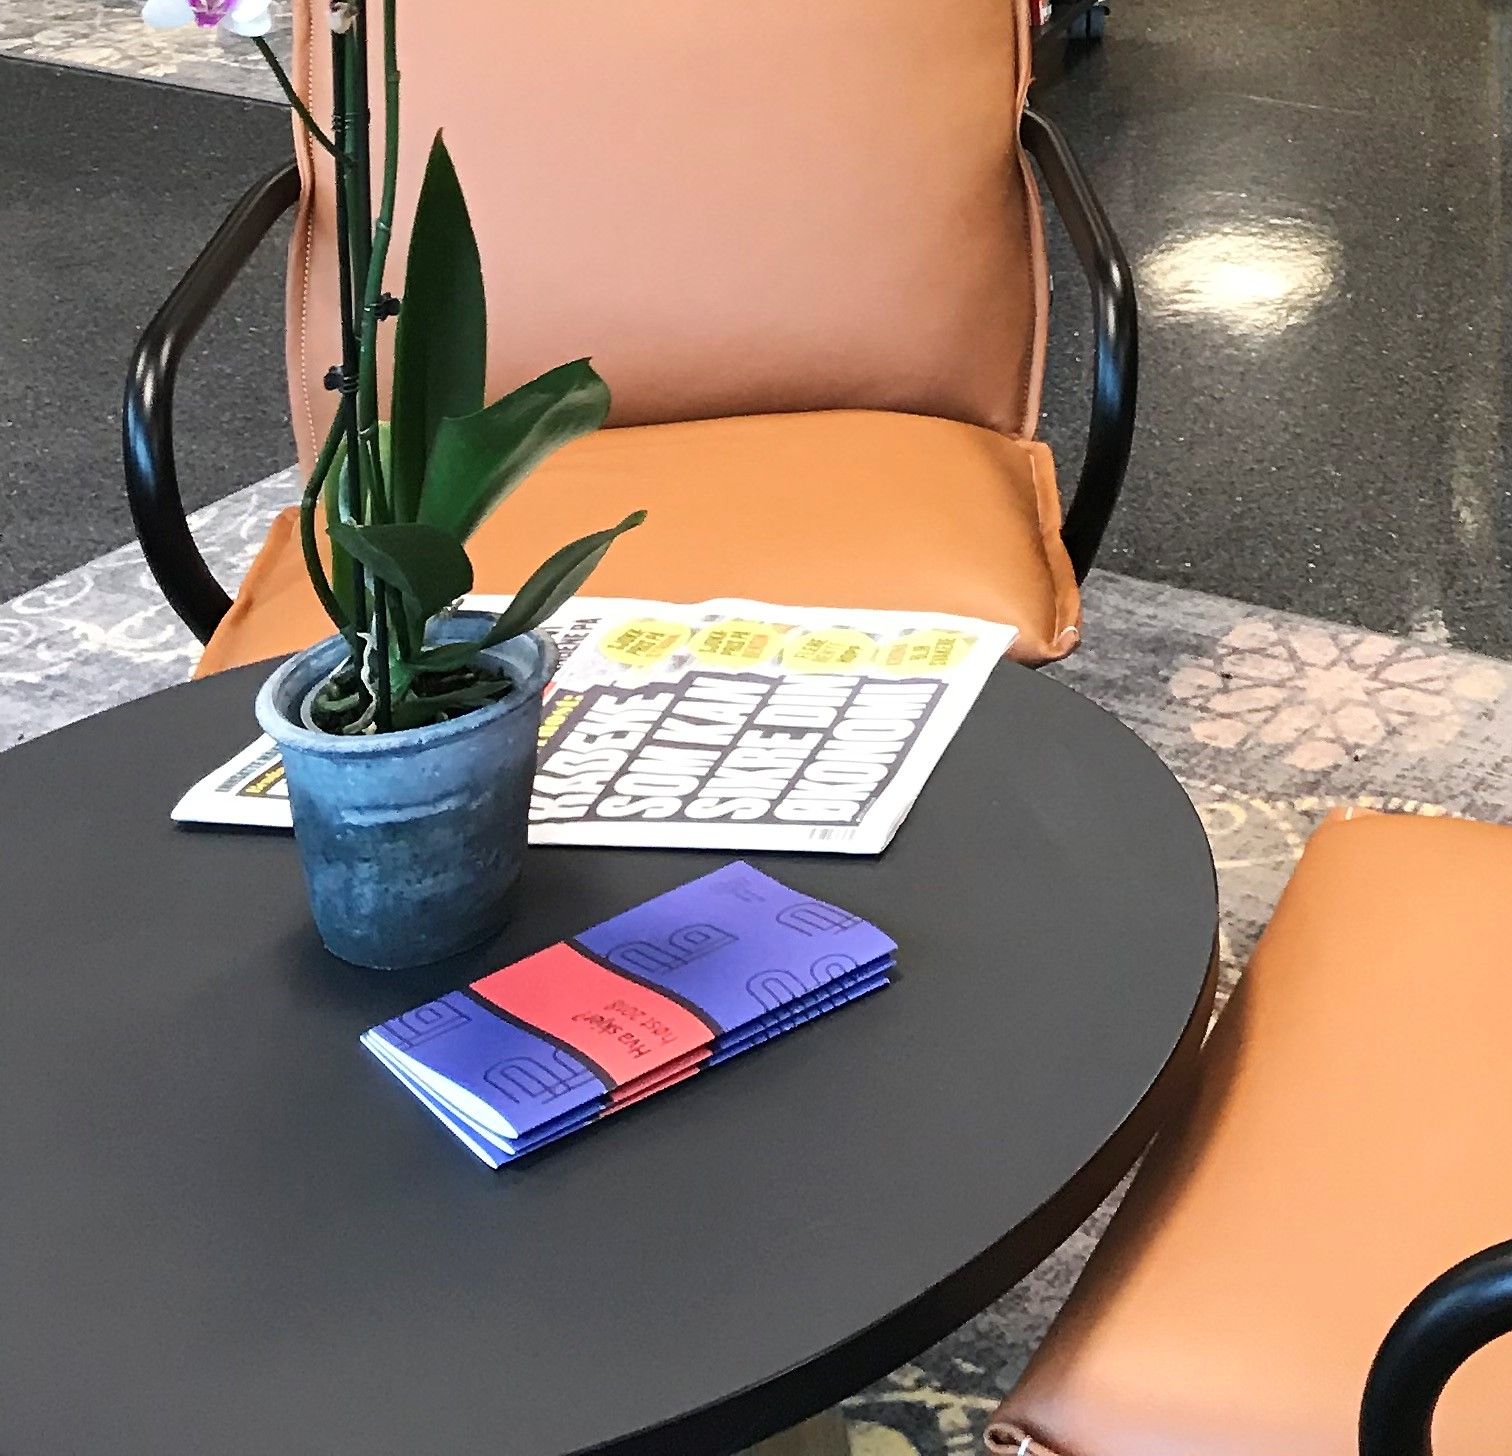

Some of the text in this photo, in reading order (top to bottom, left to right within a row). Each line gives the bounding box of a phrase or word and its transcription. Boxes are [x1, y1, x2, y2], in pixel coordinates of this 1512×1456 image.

[652, 676, 772, 746] KAN
[753, 674, 862, 729] DIN
[596, 745, 722, 818] SOM
[684, 729, 824, 819] SIKRE
[774, 682, 940, 822] ØKONOMI
